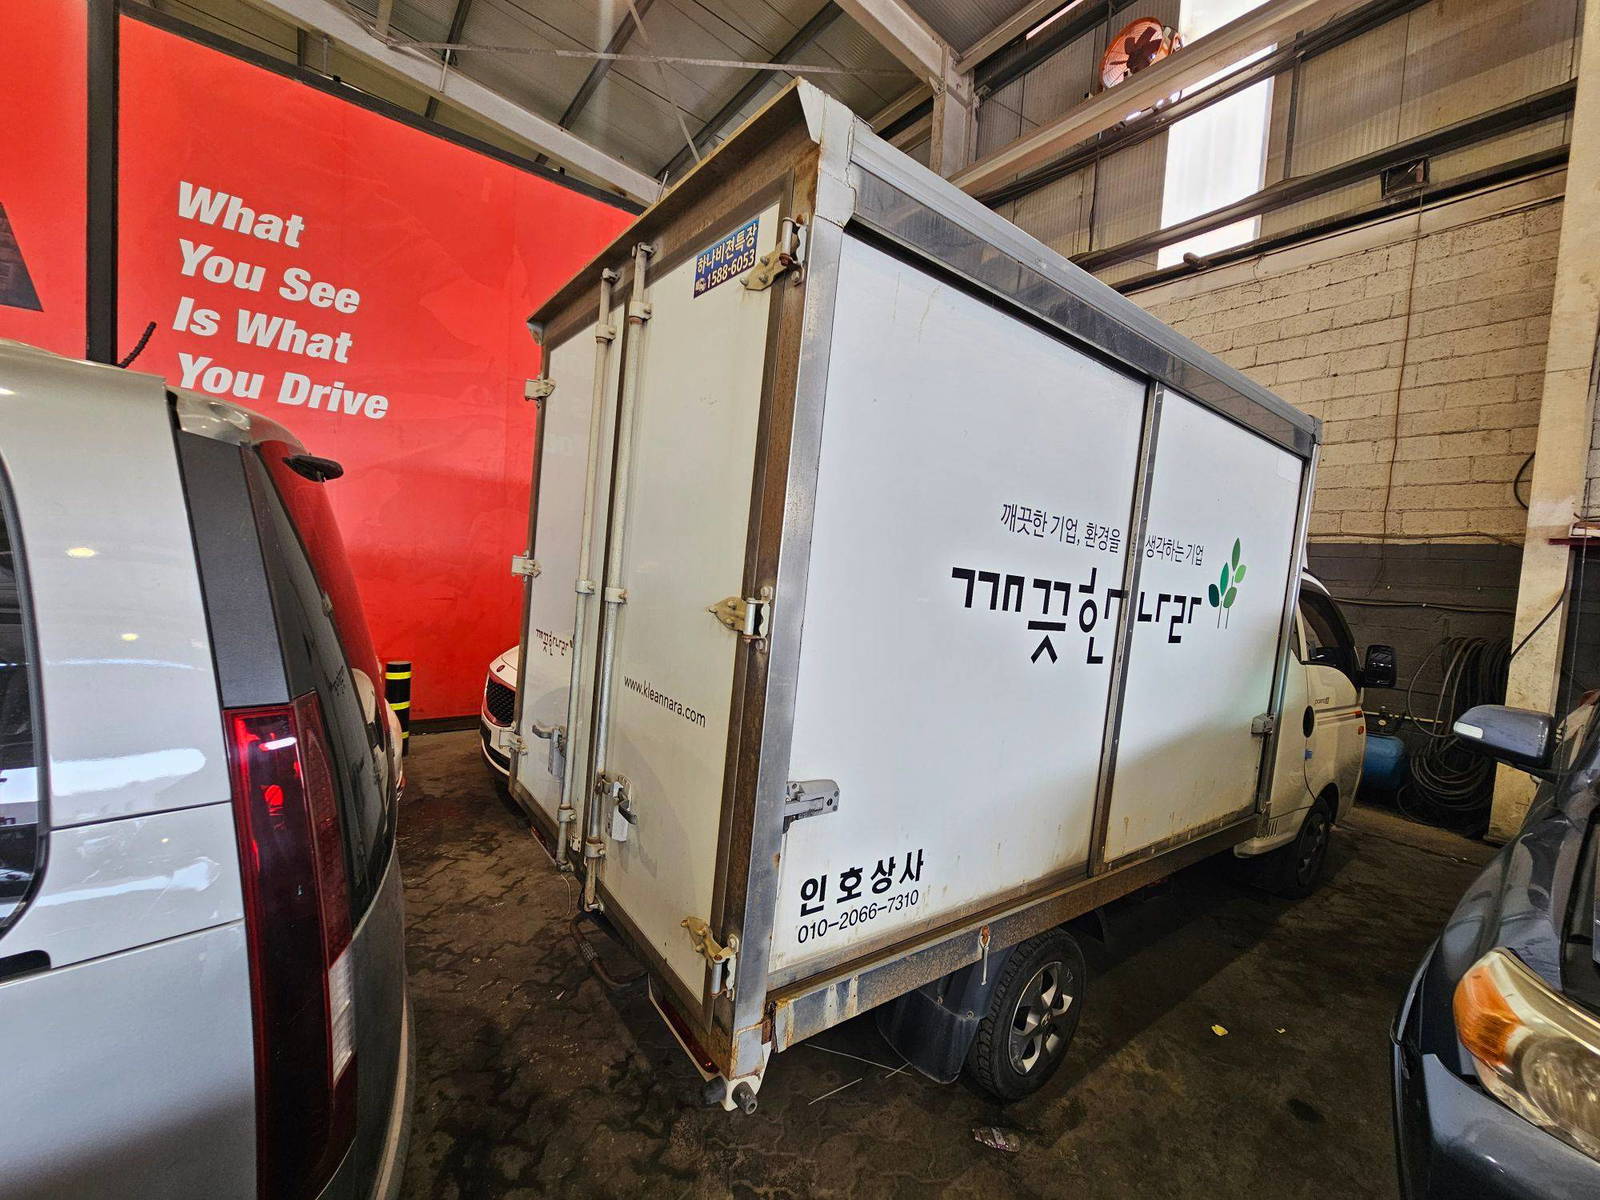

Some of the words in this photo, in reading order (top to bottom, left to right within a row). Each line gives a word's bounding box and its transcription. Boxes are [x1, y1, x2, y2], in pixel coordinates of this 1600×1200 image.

[178, 181, 304, 248] What
[179, 238, 266, 292] You
[279, 267, 360, 313] See
[707, 249, 755, 288] 1588-6053
[172, 296, 220, 336] Is
[237, 308, 352, 363] What
[178, 352, 265, 399] You
[277, 372, 388, 419] Drive
[1000, 503, 1047, 538] 깨끗한
[1050, 515, 1080, 545] 기업,
[1084, 522, 1121, 554] 환경을
[1145, 534, 1184, 563] 생각하는
[1186, 544, 1204, 566] 기업
[624, 676, 706, 728] www.kleannara.com
[797, 889, 919, 944] 010-2066-7310
